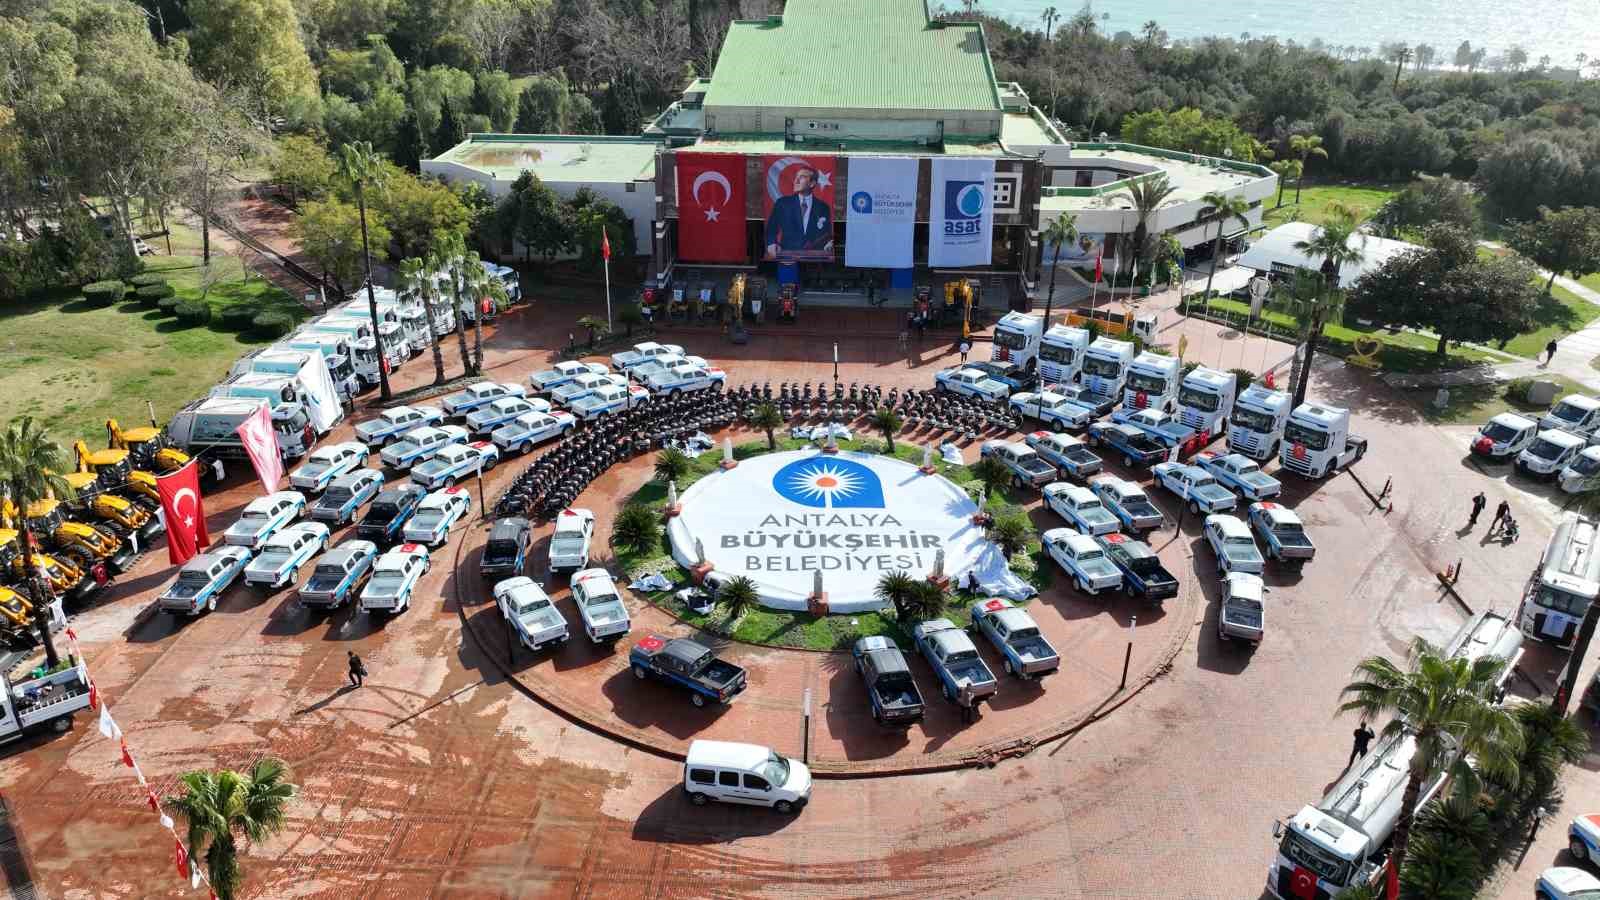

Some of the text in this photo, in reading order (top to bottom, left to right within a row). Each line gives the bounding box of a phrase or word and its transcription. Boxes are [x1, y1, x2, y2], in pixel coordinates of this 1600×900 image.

[944, 220, 982, 233] asat
[759, 513, 903, 527] ANTALYA
[720, 530, 942, 552] BÜYÜKŞEHİR
[745, 552, 923, 572] BELEDİYESİ
